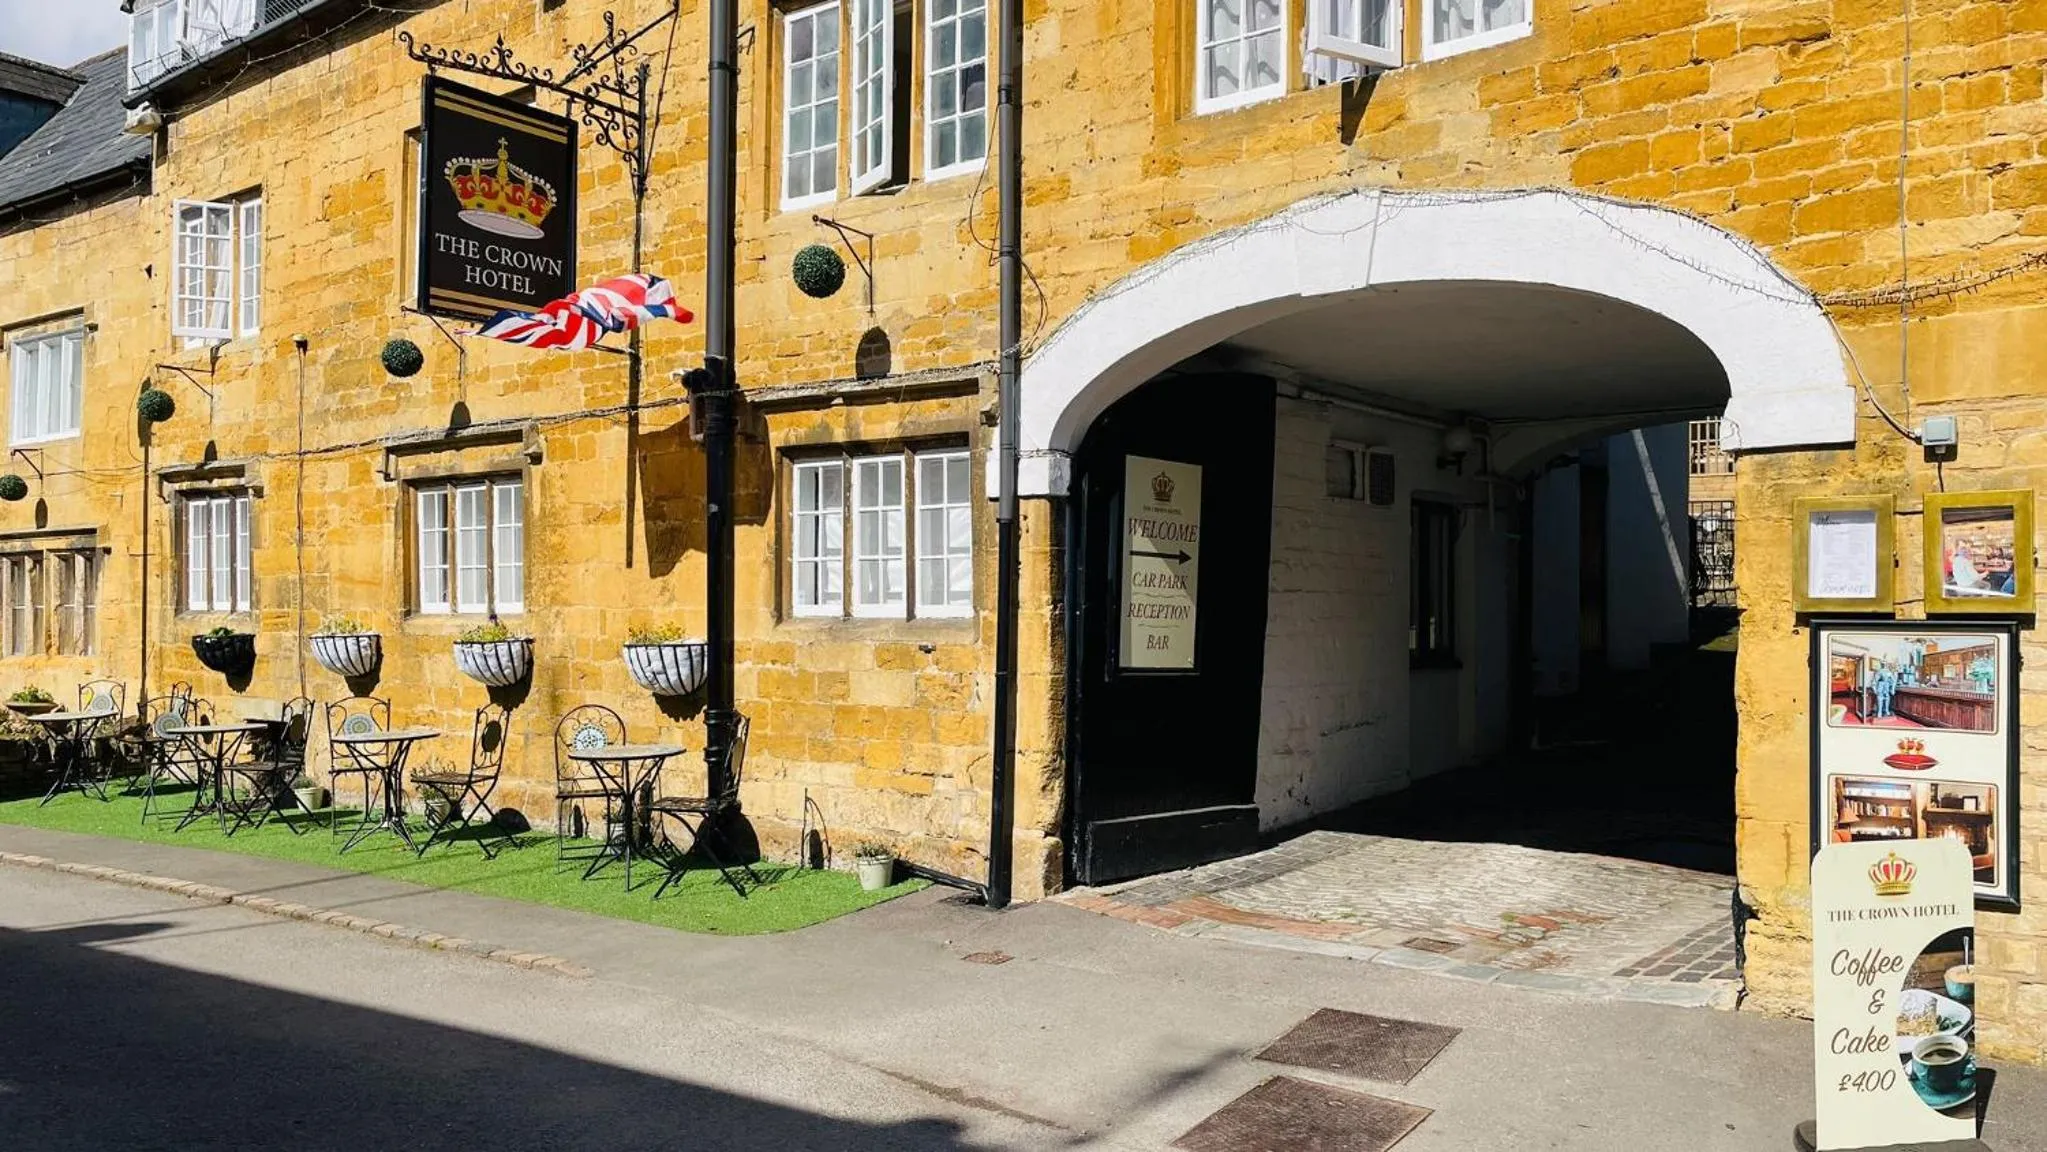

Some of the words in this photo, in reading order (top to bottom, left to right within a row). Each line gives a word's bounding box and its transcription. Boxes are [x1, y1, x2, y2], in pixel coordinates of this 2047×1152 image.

[435, 232, 480, 259] THE
[485, 245, 562, 277] CROWN
[465, 264, 536, 296] HOTEL
[1128, 518, 1198, 543] WELCOME
[1133, 571, 1156, 588] CAR
[1158, 573, 1188, 590] PARK
[1127, 601, 1190, 619] RECEPTION
[1147, 634, 1169, 650] BAR
[1827, 909, 1856, 922] THE
[1859, 906, 1910, 920] CROWN
[1912, 903, 1959, 918] HOTEL
[1831, 948, 1904, 987] Coffee
[1868, 988, 1886, 1014] &
[1831, 1025, 1890, 1055] Cake
[1839, 1069, 1896, 1093] £4.00
